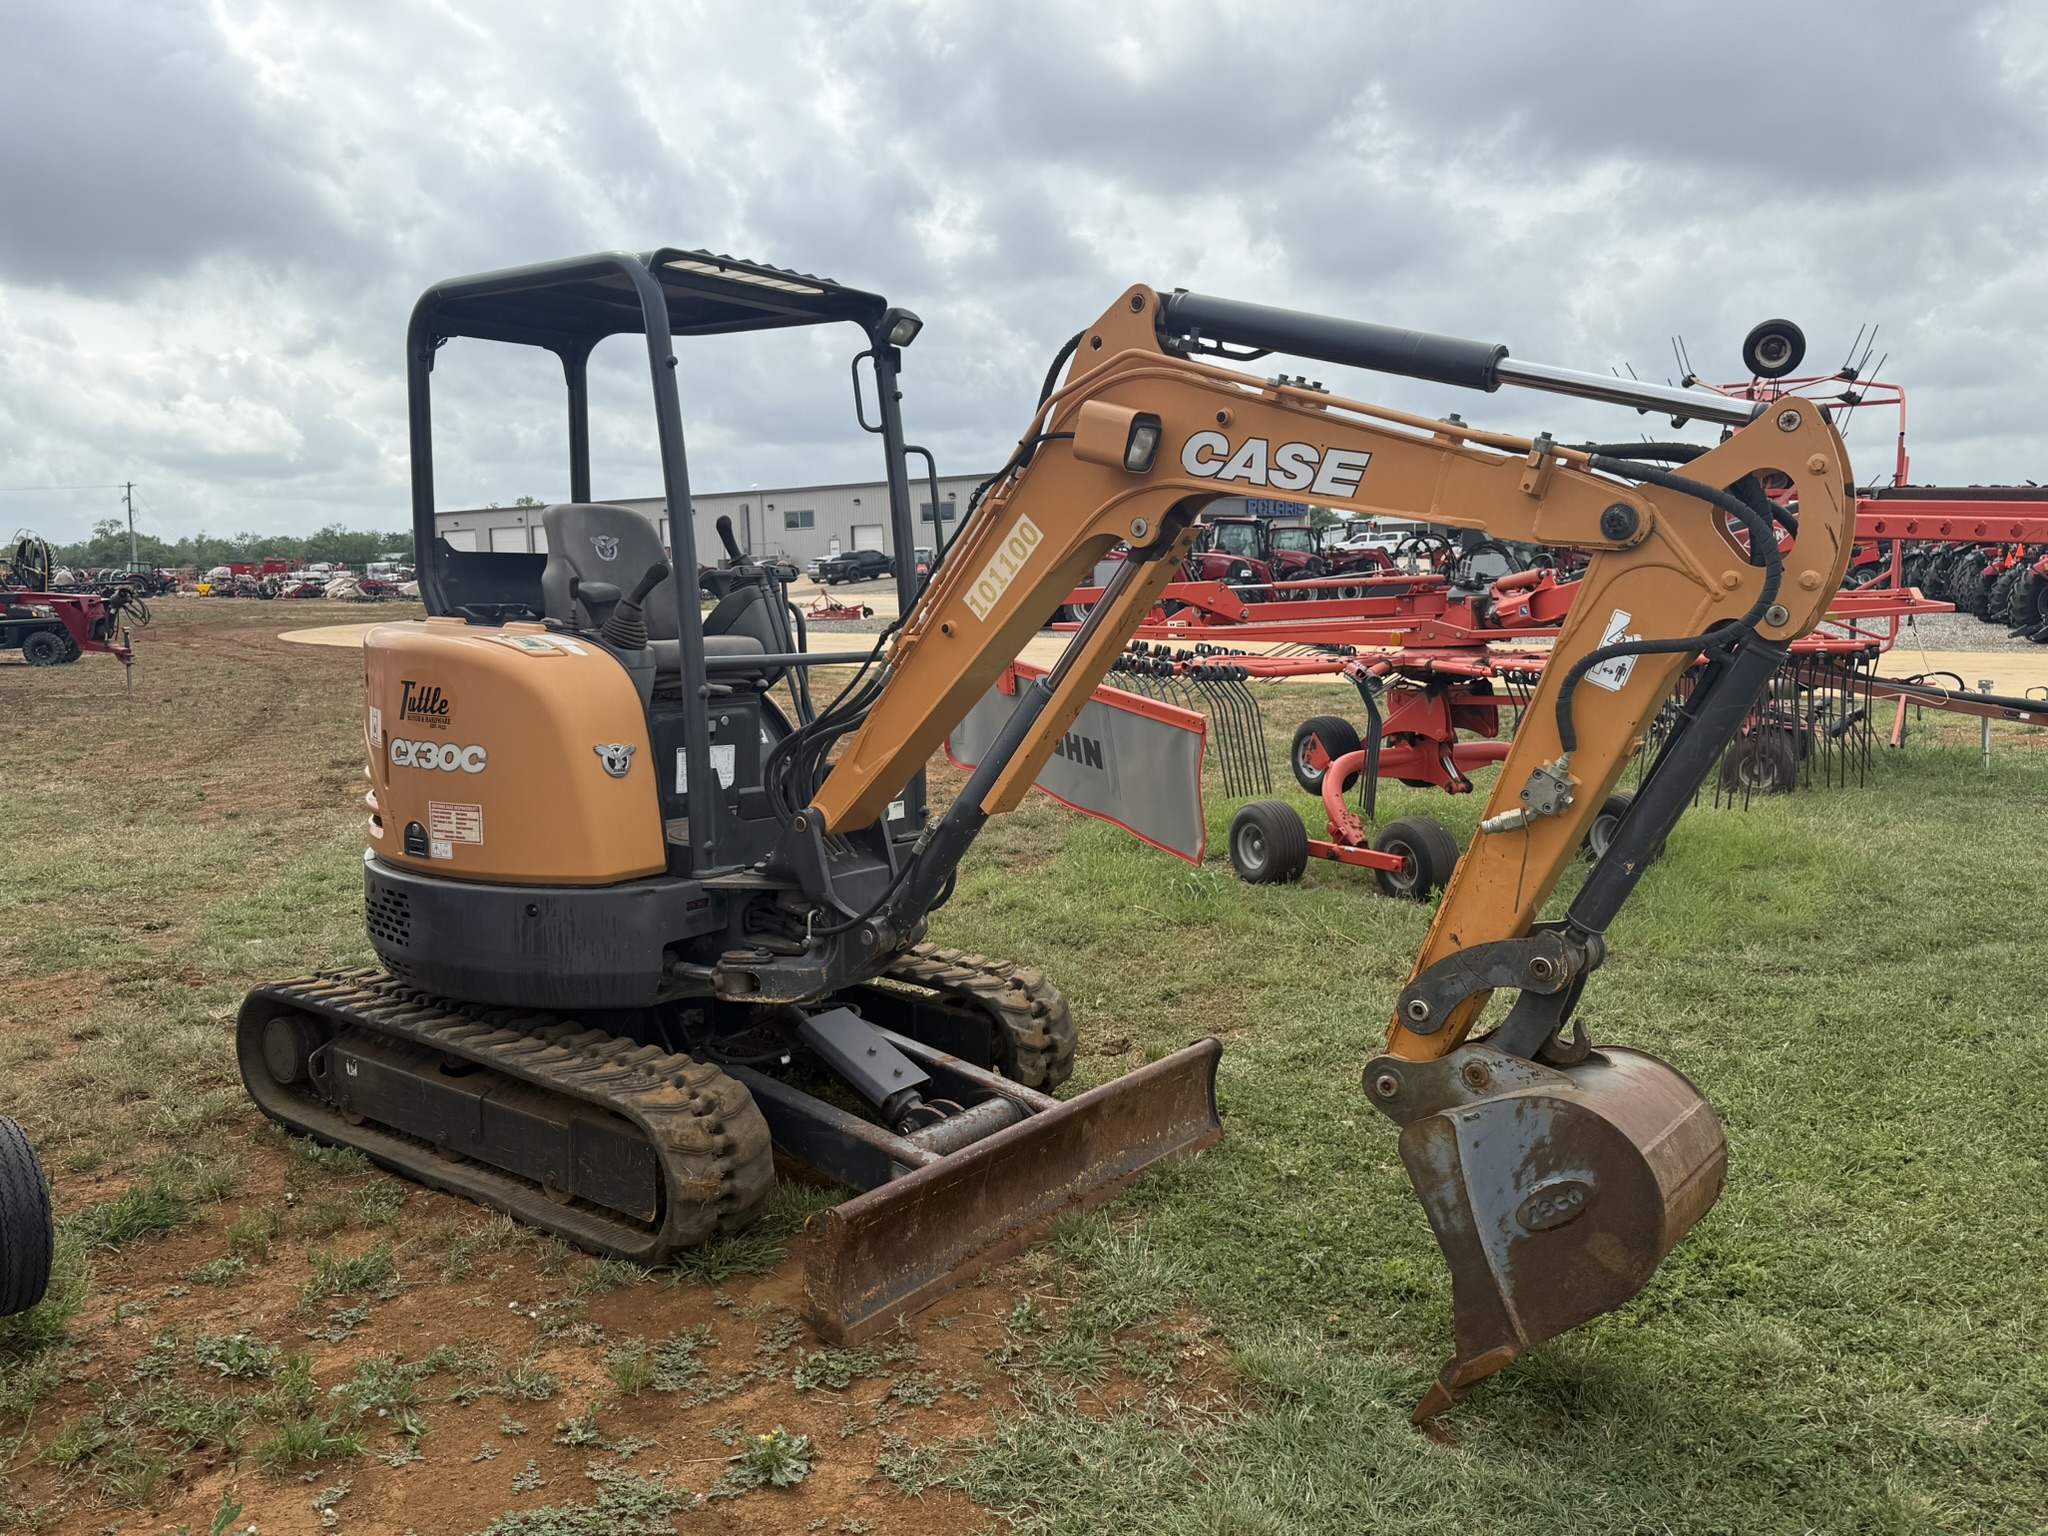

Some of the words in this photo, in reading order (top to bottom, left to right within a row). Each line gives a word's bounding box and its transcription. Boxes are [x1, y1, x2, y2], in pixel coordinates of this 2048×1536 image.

[1180, 431, 1373, 498] CASE
[1247, 500, 1307, 516] POLARIS
[968, 521, 1040, 618] 101100
[399, 680, 450, 720] Tuttle
[425, 716, 451, 724] HARDWARE
[390, 738, 488, 774] CX30C
